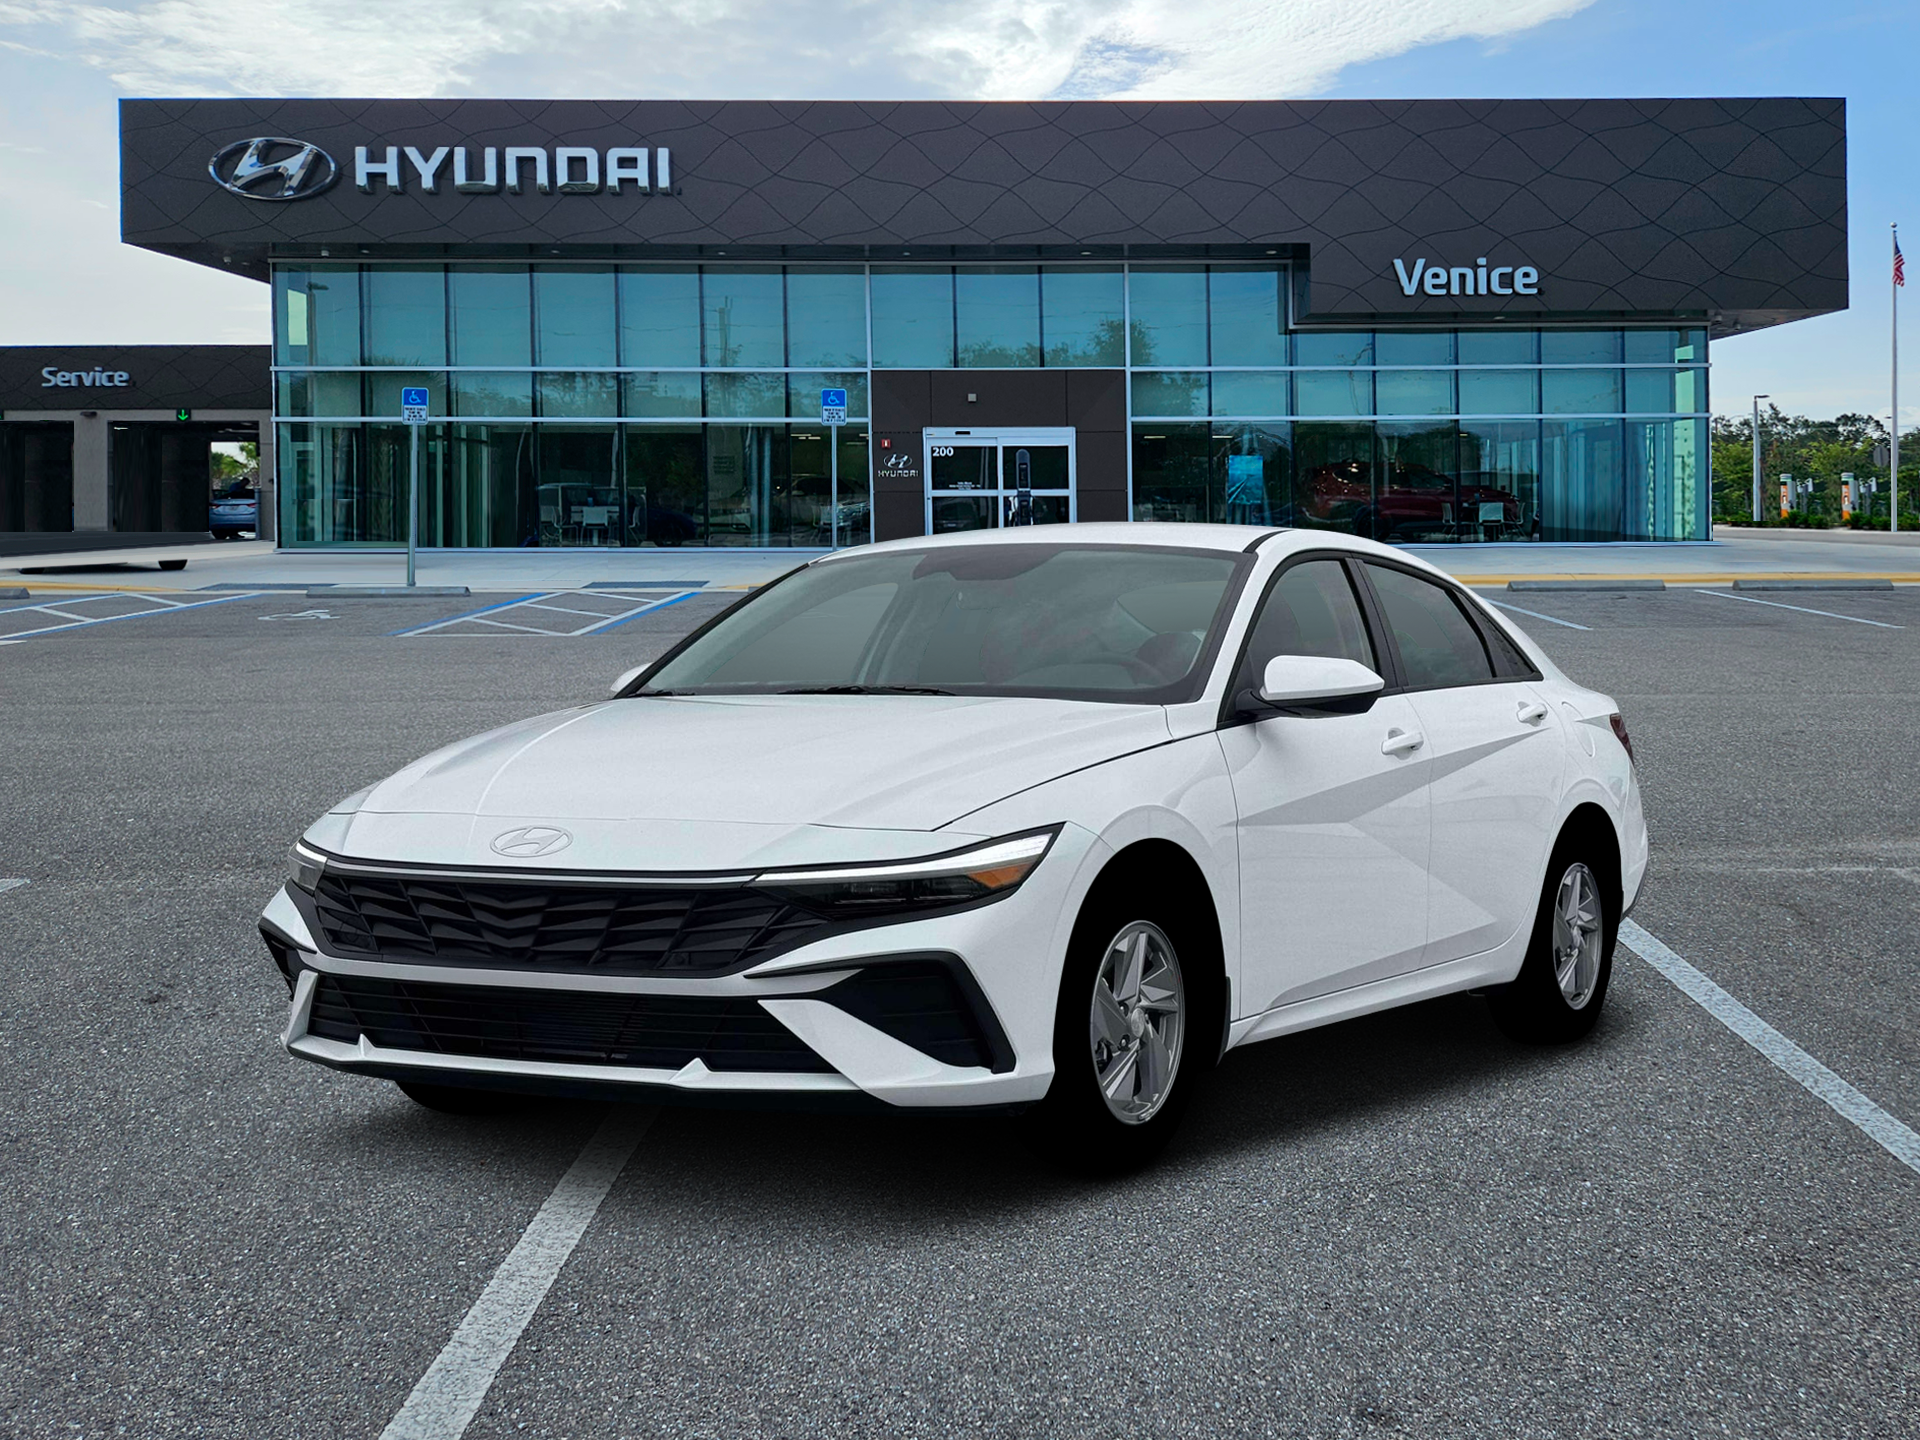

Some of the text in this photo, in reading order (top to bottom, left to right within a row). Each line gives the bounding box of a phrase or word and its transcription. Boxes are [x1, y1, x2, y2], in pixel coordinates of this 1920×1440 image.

[355, 146, 671, 193] HYUNDAI
[1393, 257, 1539, 295] Venice
[41, 366, 130, 387] Service
[932, 446, 954, 457] 200
[877, 470, 919, 478] HYUNDAI
